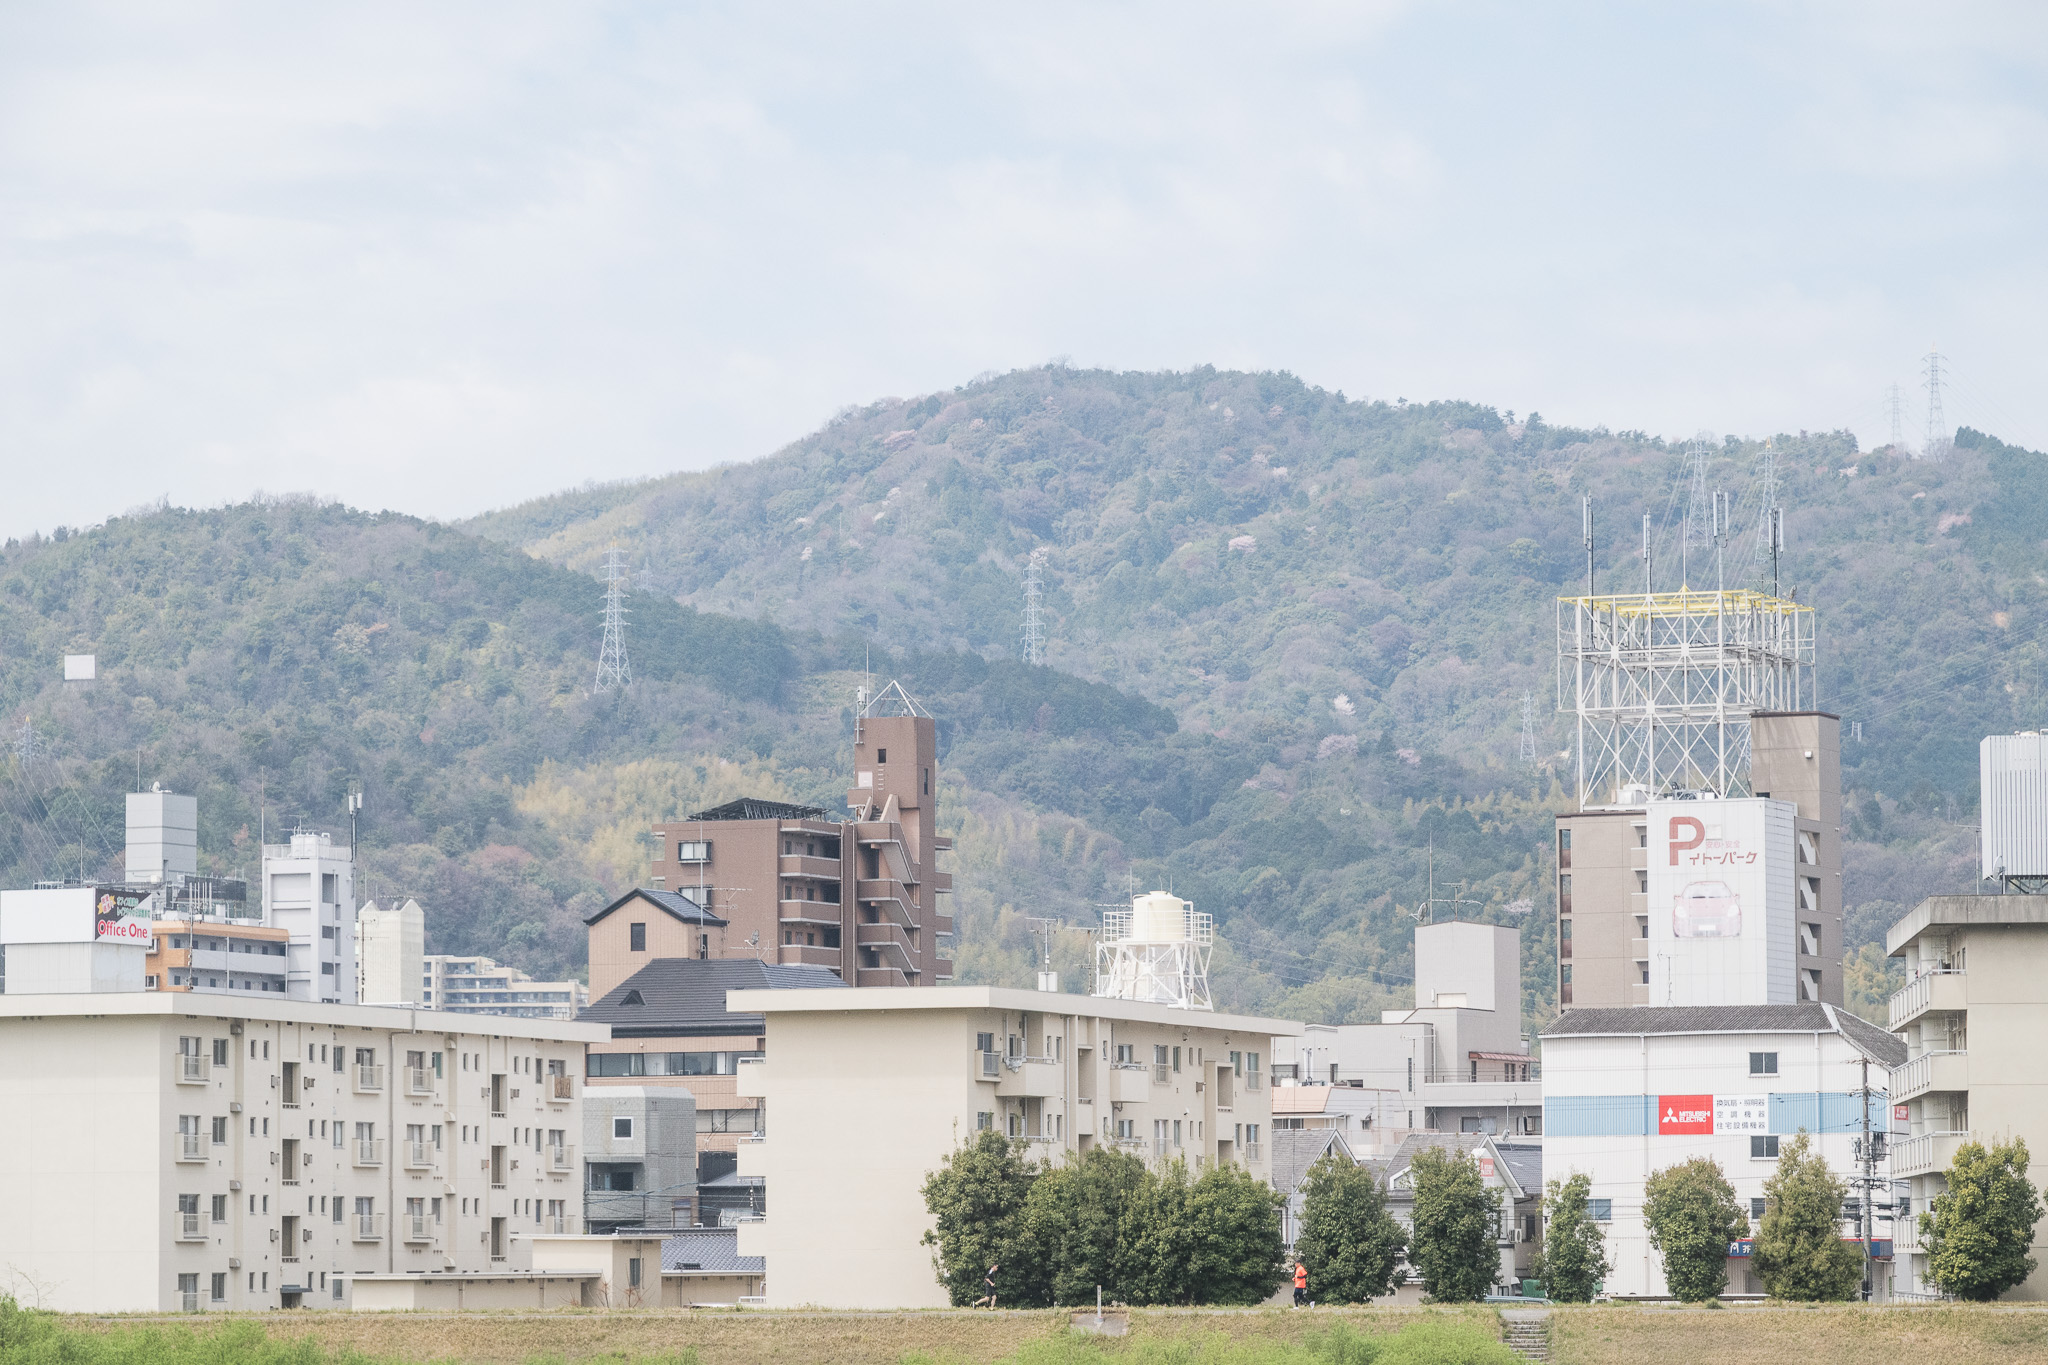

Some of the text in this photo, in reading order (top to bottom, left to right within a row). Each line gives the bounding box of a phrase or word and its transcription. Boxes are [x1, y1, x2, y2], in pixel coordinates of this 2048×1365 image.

[1669, 816, 1706, 866] P
[1689, 851, 1758, 866] イトーパーク
[98, 920, 148, 938] Office One
